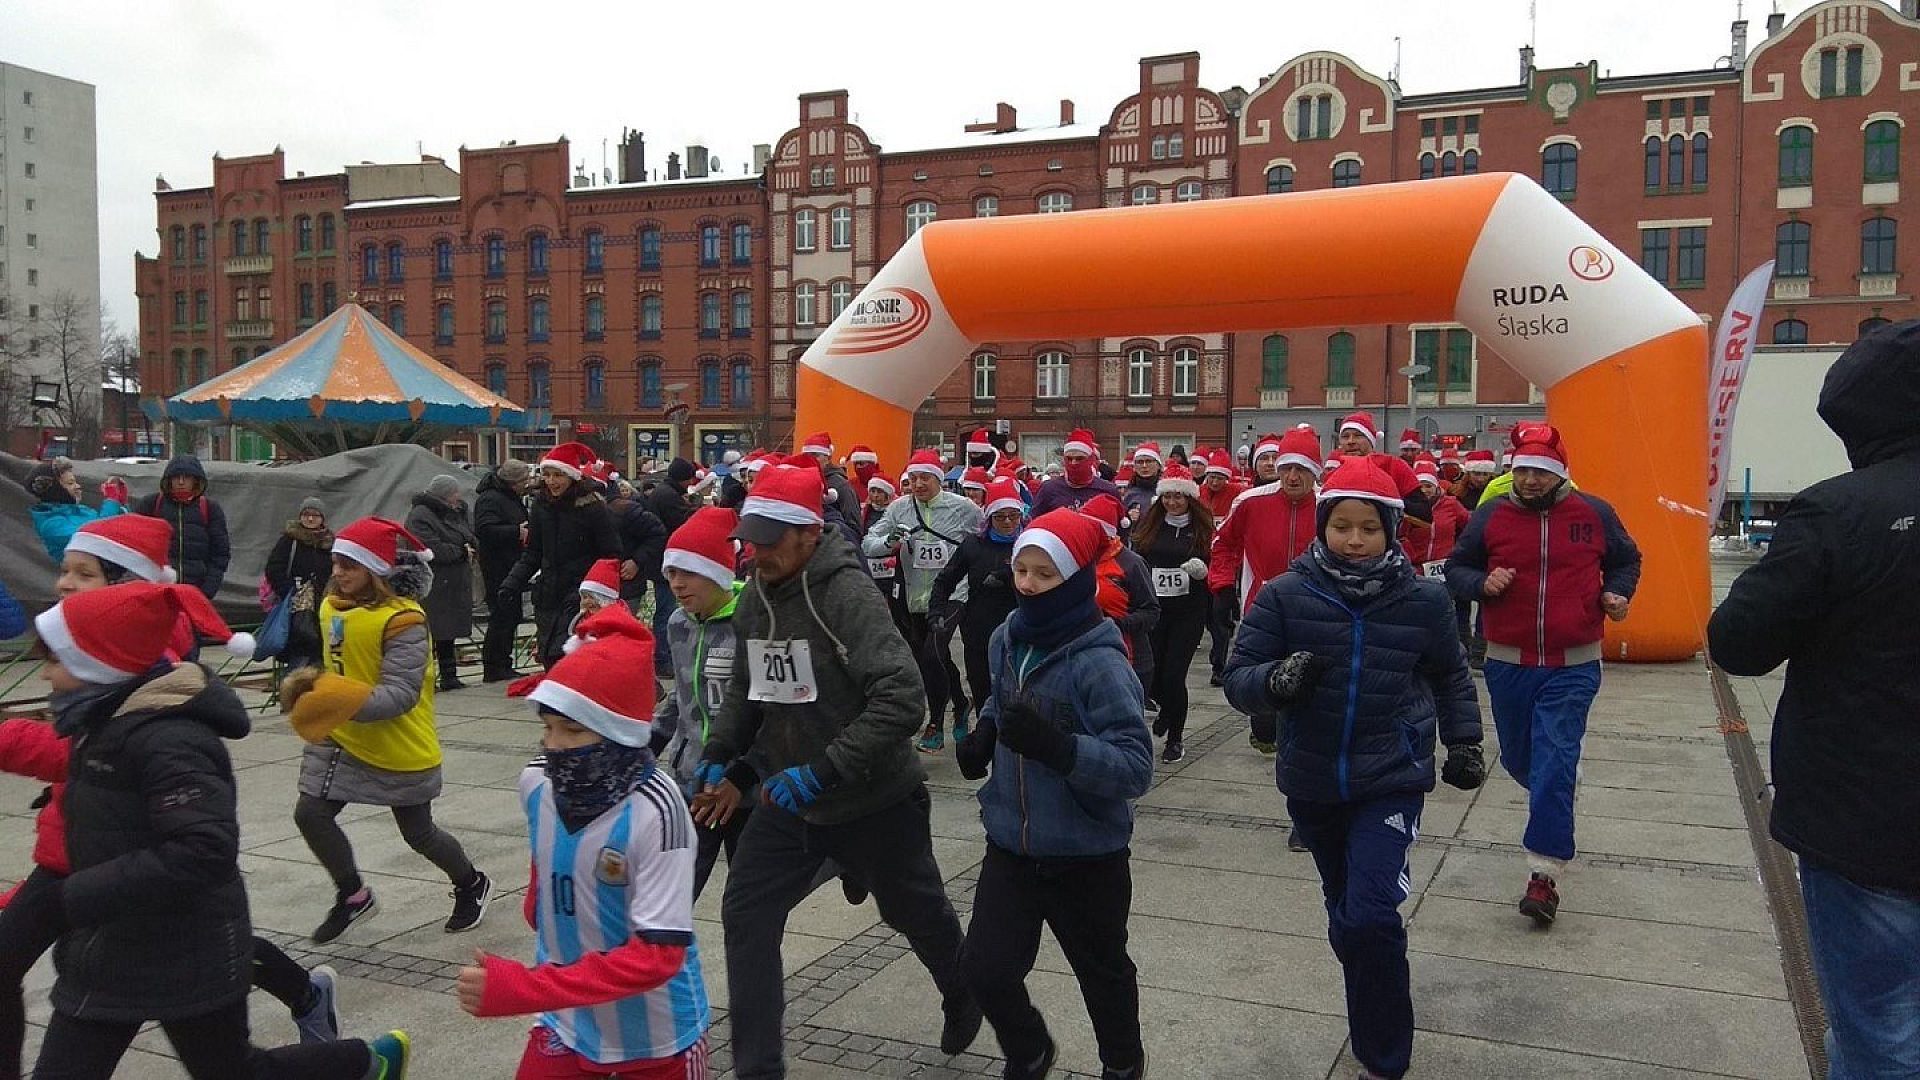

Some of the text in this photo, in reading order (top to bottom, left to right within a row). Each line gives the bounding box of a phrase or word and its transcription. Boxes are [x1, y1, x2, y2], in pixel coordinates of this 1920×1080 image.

[1493, 283, 1569, 307] RUDA
[1498, 313, 1569, 340] Śląska
[1890, 515, 1916, 531] 4F
[920, 547, 942, 560] 213
[1430, 564, 1444, 576] 20
[1158, 574, 1182, 588] 215
[763, 652, 798, 683] 201
[551, 871, 575, 917] 10
